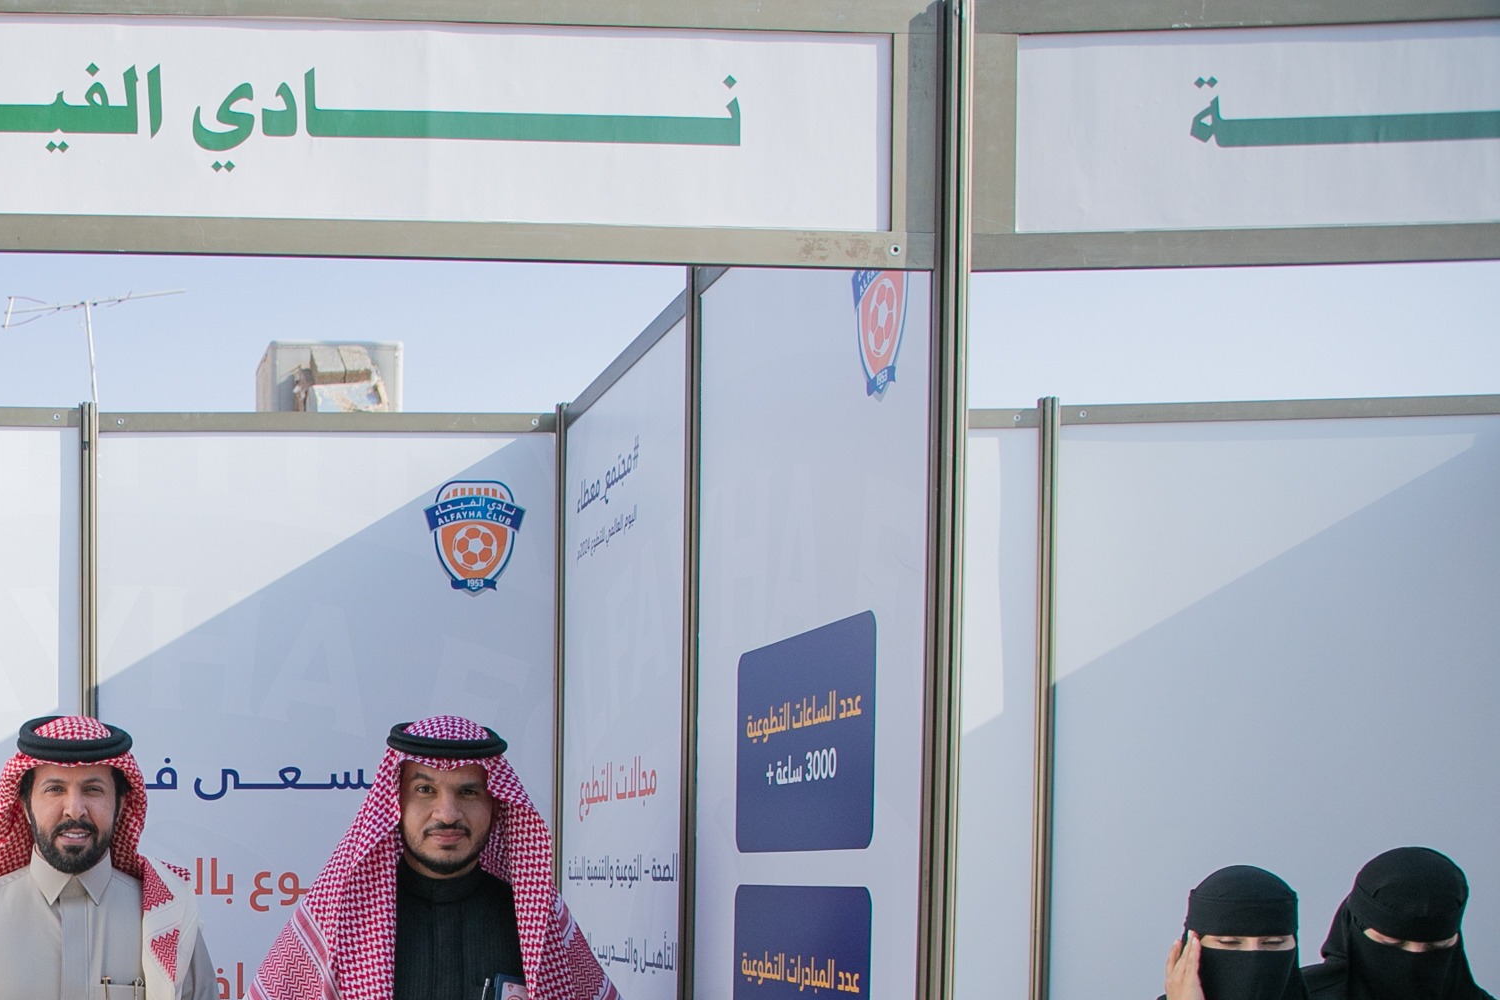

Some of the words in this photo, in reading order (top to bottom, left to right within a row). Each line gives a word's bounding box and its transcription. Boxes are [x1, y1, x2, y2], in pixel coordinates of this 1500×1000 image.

[191, 67, 742, 172] نادي
[435, 497, 486, 516] الفيحاء
[437, 510, 483, 526] ALFAYHA
[486, 511, 512, 526] CLUB
[487, 500, 517, 516] نادي
[467, 579, 484, 587] 1953
[746, 701, 791, 743] التطوعية
[792, 689, 837, 730] الساعات
[838, 694, 862, 719] عدد
[616, 755, 657, 807] مجالات
[776, 755, 802, 785] ساعة
[805, 747, 837, 782] 3000
[194, 766, 375, 801] سعى
[579, 761, 612, 822] التطوع
[587, 855, 614, 889] والتنمية
[615, 854, 642, 889] التوعية
[651, 853, 678, 882] الصحة
[598, 937, 638, 973] والتدريب
[640, 931, 678, 975] التأهيل
[741, 951, 785, 986] التطوعية
[787, 955, 835, 994] المبادرات
[837, 970, 860, 994] عدد
